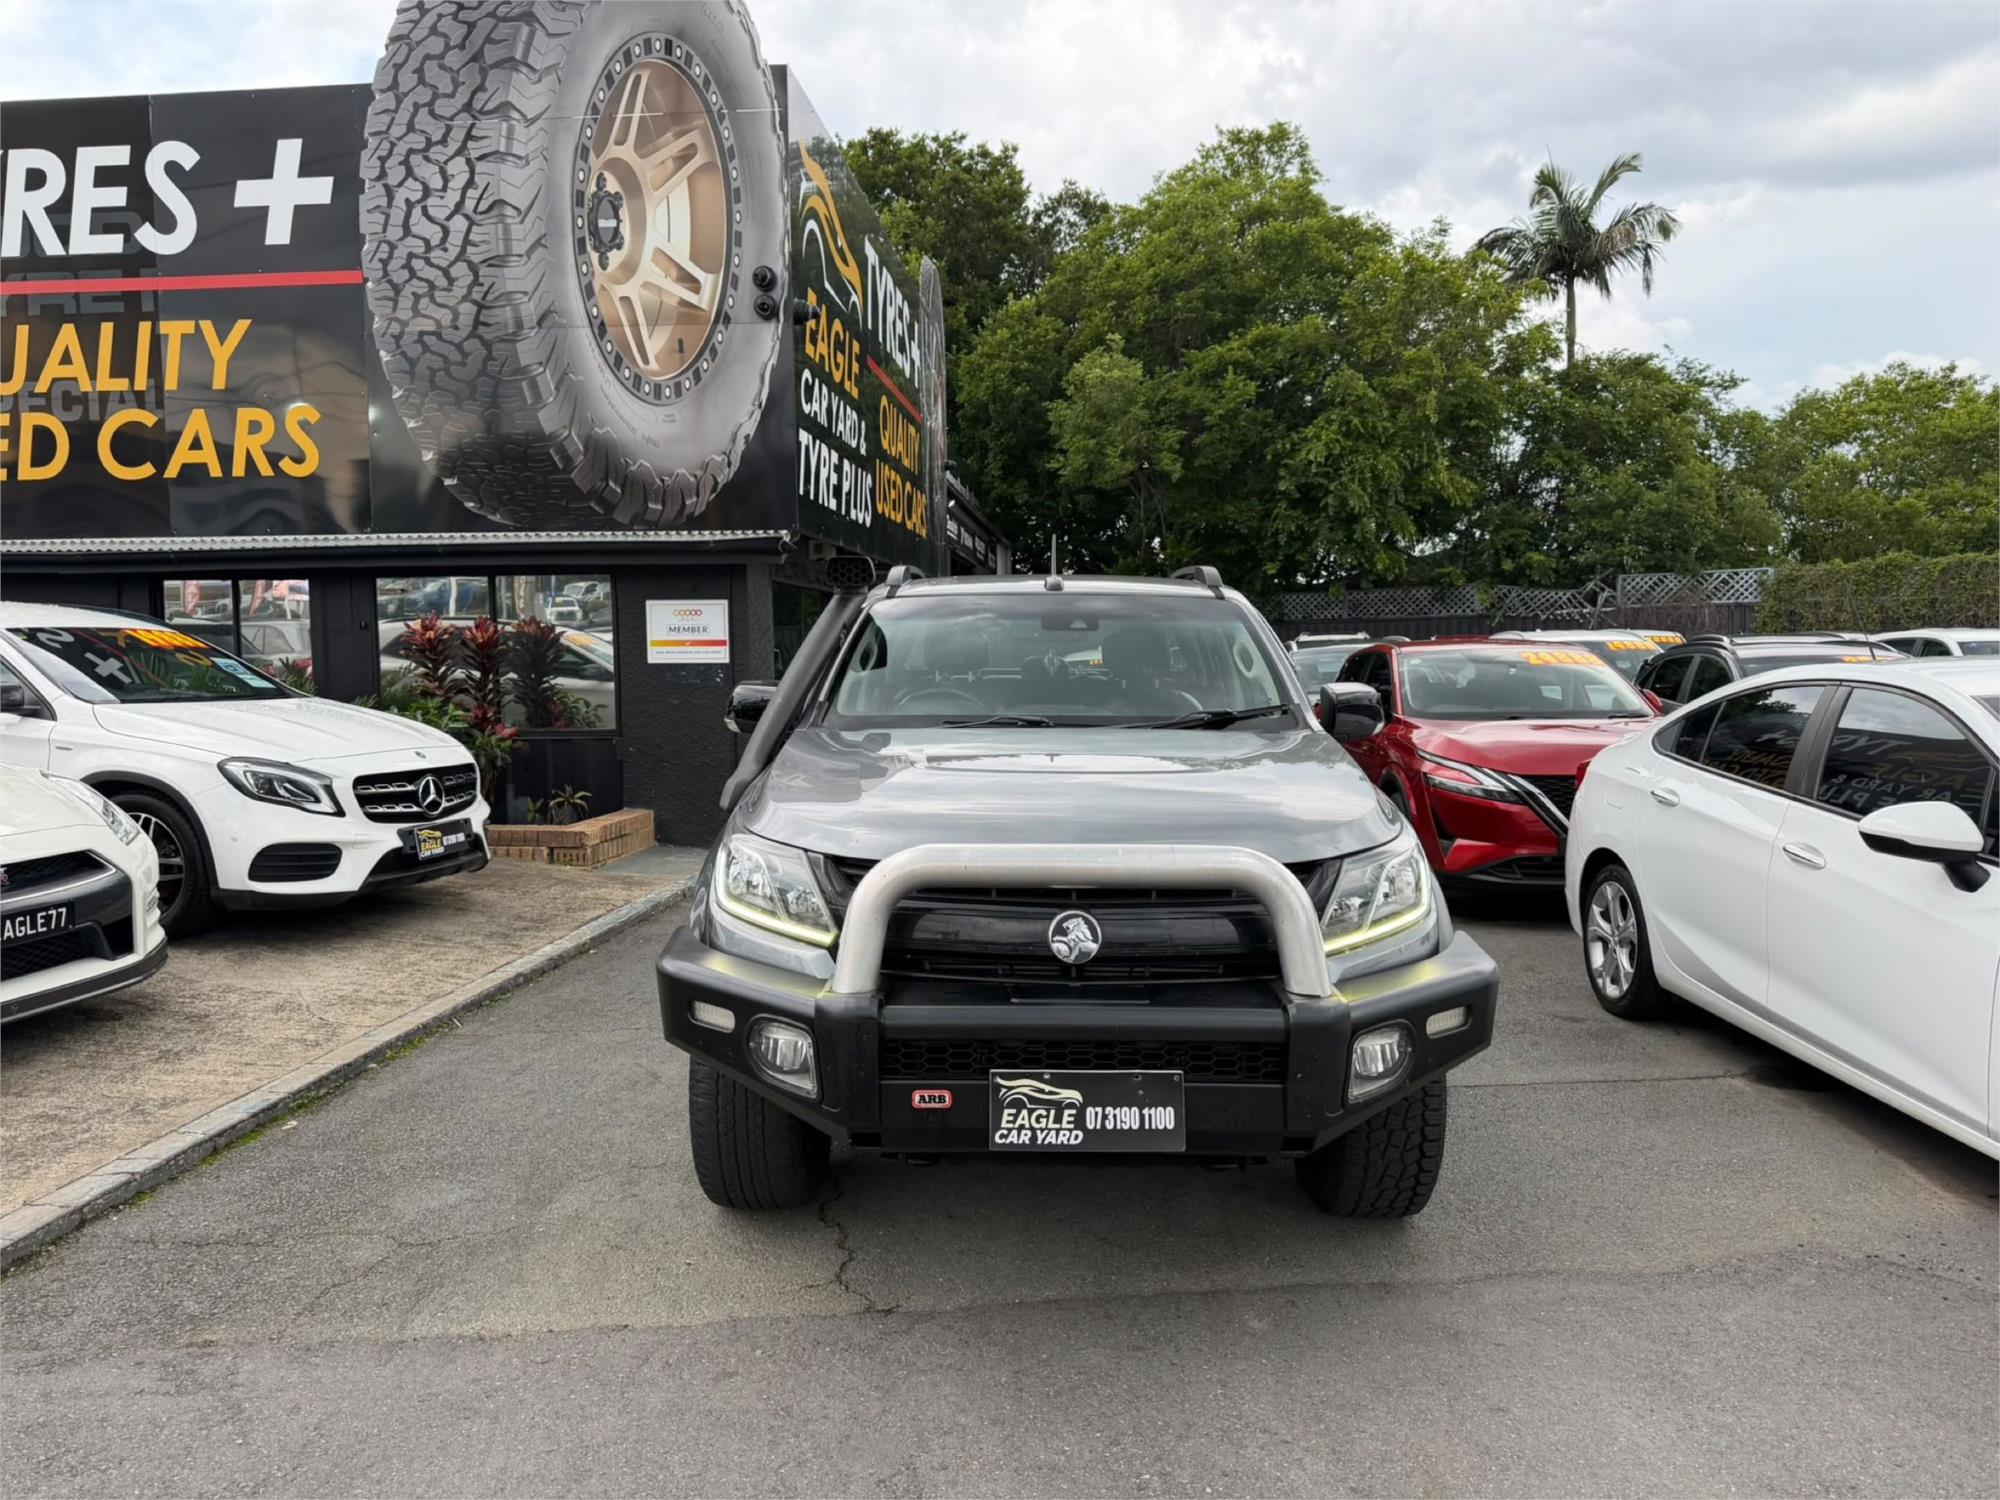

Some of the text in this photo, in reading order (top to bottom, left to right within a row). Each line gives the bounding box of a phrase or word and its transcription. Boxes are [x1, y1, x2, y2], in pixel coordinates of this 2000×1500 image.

[0, 140, 200, 257] RES
[805, 286, 861, 400] EAGLE
[0, 402, 322, 481] D CARS
[801, 368, 867, 456] CAR YARD &
[879, 394, 920, 476] QUALITY
[799, 427, 873, 528] TYRE PLUS
[876, 458, 928, 540] USED CARS
[668, 625, 708, 634] MEMBER
[0, 906, 67, 941] AGLE77
[917, 1094, 948, 1105] ARB
[994, 1129, 1084, 1145] CAR YARD
[1000, 1106, 1176, 1130] EAGLE 07 3190 1100
